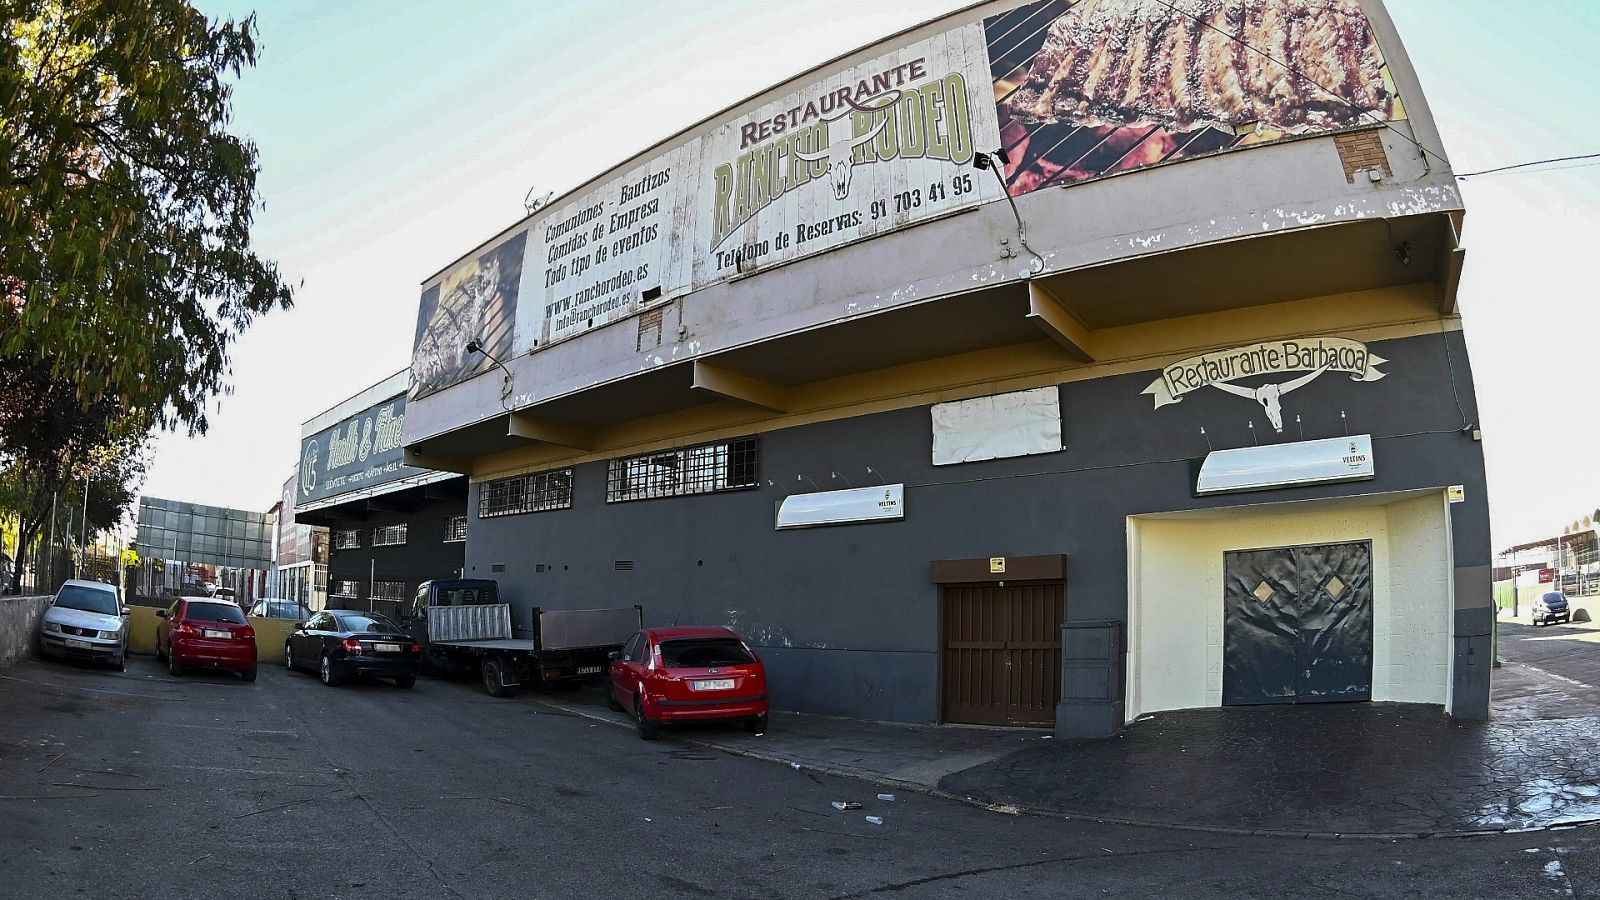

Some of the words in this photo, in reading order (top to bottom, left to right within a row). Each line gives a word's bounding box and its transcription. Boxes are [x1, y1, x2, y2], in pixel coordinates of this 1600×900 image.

[740, 57, 927, 150] RESTAURANTE
[710, 121, 830, 253] RANCHO
[850, 72, 975, 165] RODEO
[545, 201, 604, 243] Comuniones
[619, 168, 671, 205] Bautizos
[547, 231, 588, 264] Comidas
[592, 222, 605, 242] de
[608, 197, 659, 235] Empresa
[715, 239, 769, 271] Teléfono
[775, 231, 790, 251] de
[796, 210, 863, 244] Reservas:
[870, 198, 887, 221] 91
[894, 189, 922, 213] 703
[928, 180, 946, 203] 41
[952, 173, 973, 196] 95
[544, 264, 567, 288] Todo
[570, 252, 592, 277] tipo
[595, 245, 608, 265] de
[612, 223, 658, 258] eventos
[545, 263, 649, 319] www.ranchorodeo.es
